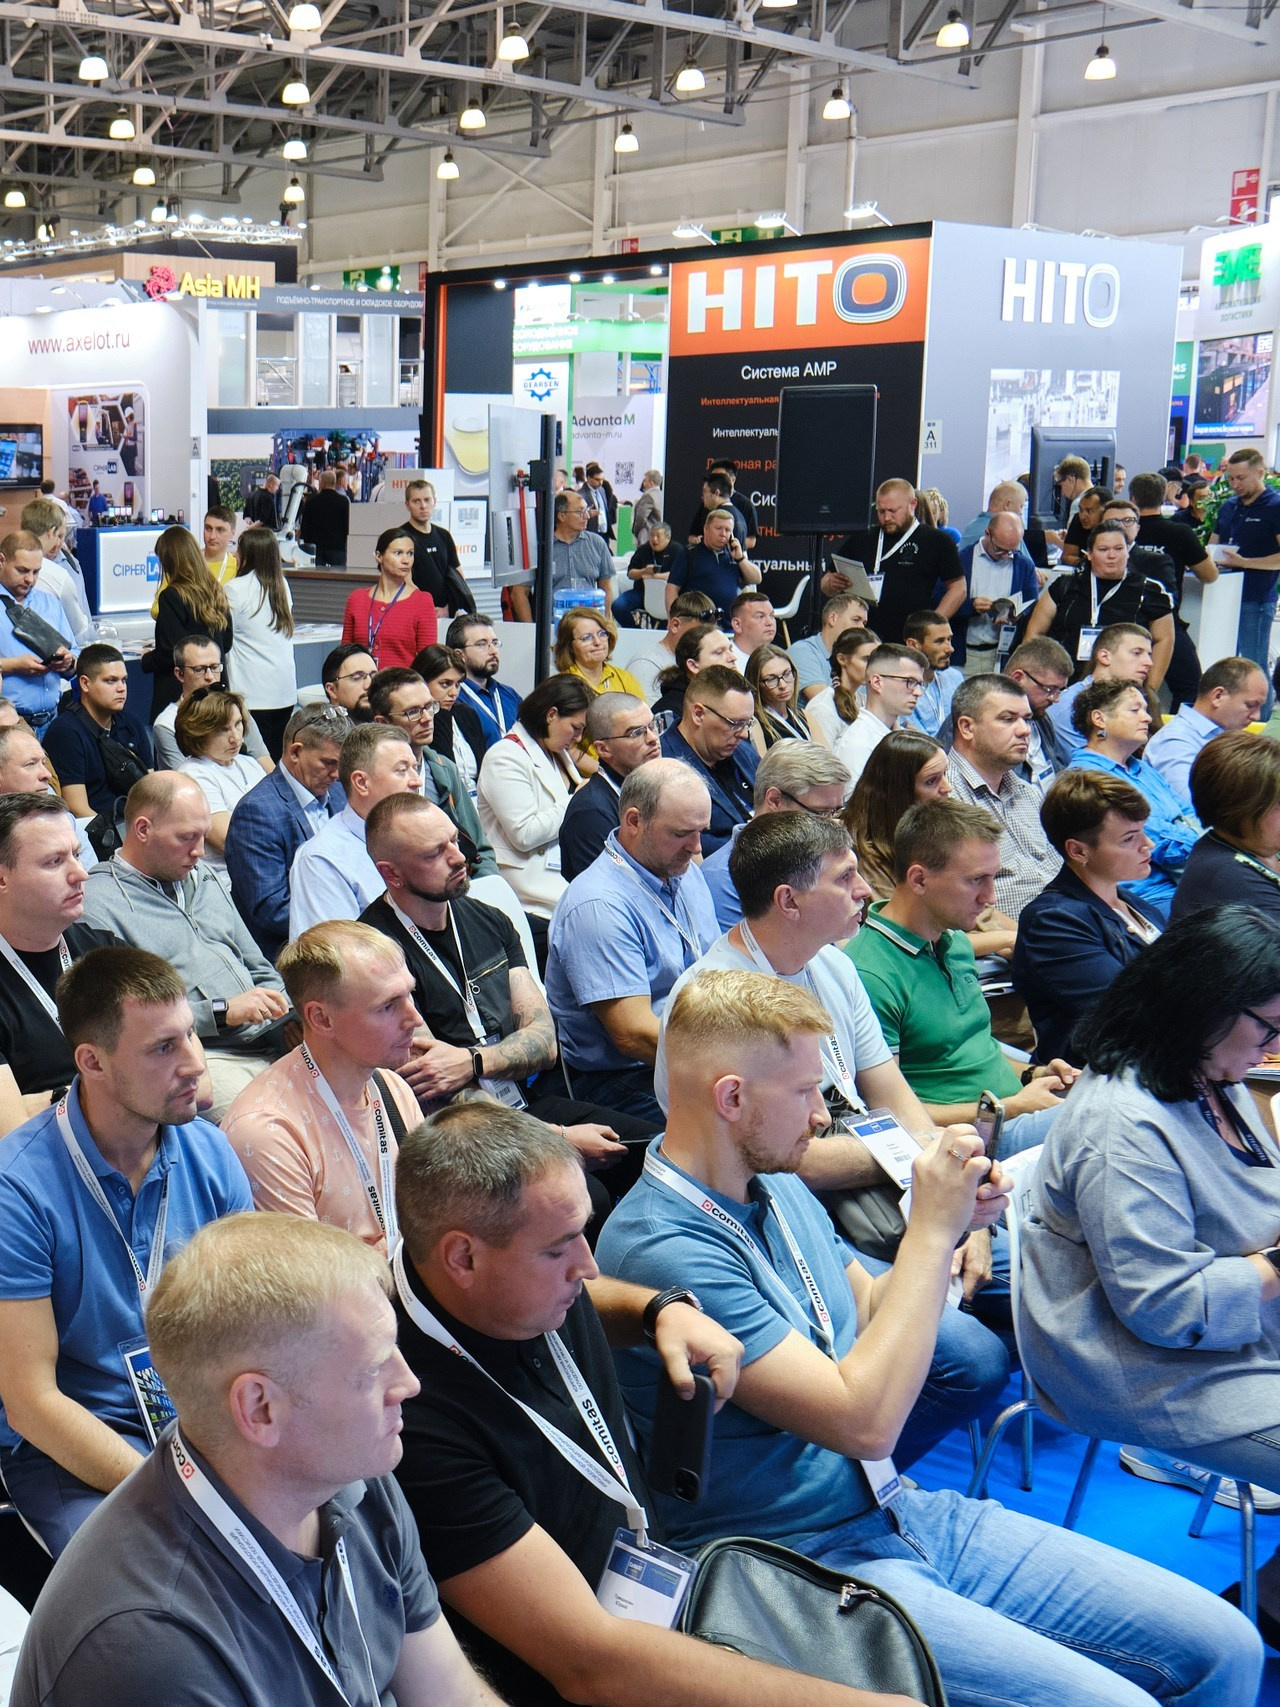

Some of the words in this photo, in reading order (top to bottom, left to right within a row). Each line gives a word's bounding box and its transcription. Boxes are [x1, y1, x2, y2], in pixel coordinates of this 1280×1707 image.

[179, 271, 223, 297] Asia
[226, 274, 261, 299] MH
[687, 252, 908, 334] HITO
[1000, 256, 1120, 328] HITO
[28, 331, 130, 355] www.axelot.ru
[523, 381, 559, 389] GEARSEN
[741, 364, 800, 380] Система
[701, 395, 780, 406] Интеллектуальная
[712, 428, 779, 439] Интеллектуаль
[924, 441, 937, 449] 311
[392, 480, 409, 489] HIT
[113, 560, 160, 577] CIPHERLA
[413, 932, 437, 961] comitas
[829, 1035, 846, 1073] comitas
[374, 1108, 388, 1153] comitas
[368, 1185, 385, 1233] comitas
[711, 1206, 754, 1250] comitas
[797, 1258, 825, 1313] comitas
[582, 1398, 620, 1467] comitas
